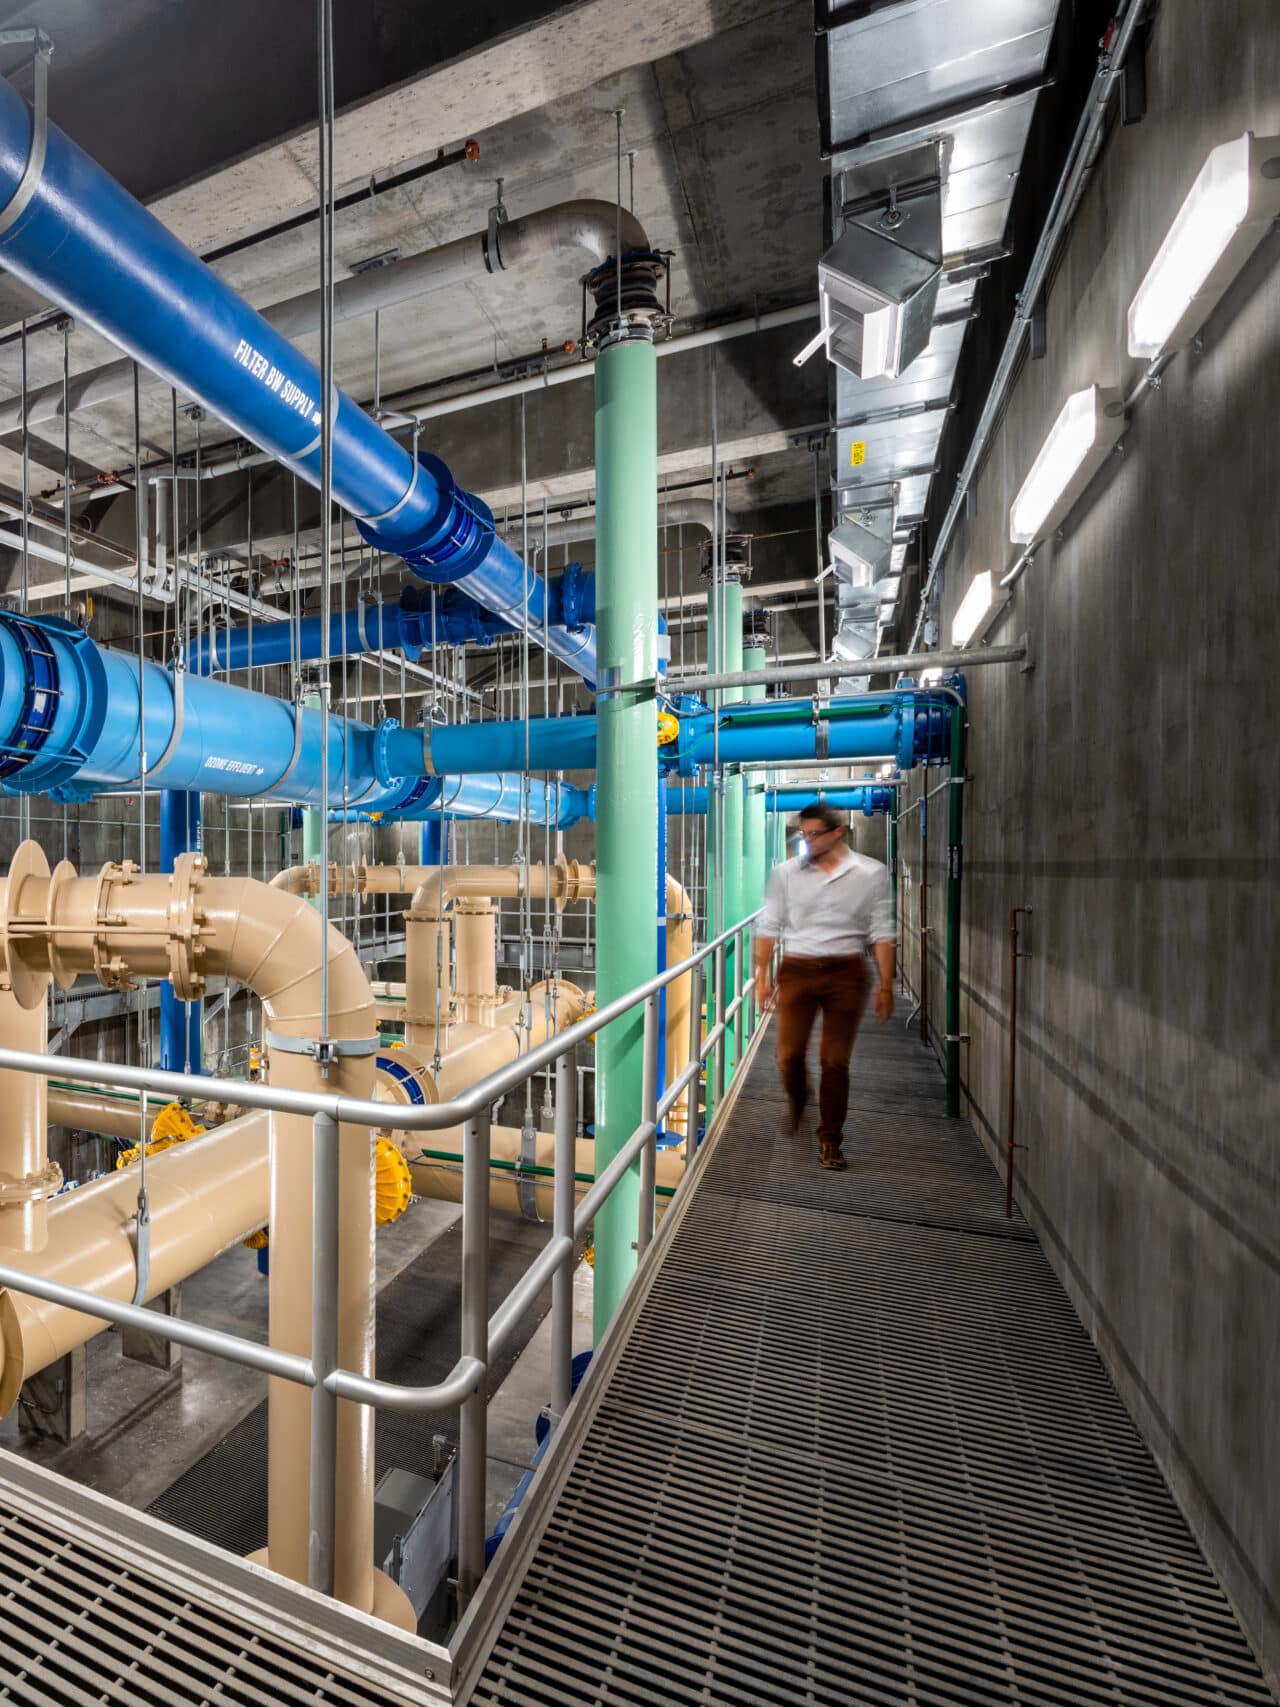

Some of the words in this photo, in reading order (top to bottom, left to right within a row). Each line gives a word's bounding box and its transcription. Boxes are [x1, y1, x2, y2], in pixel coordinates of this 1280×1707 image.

[233, 338, 269, 380] FILTER
[265, 366, 285, 392] BW
[280, 379, 315, 417] SUPPLY
[204, 756, 229, 770] OZONE
[225, 760, 257, 775] EFFLUENT
